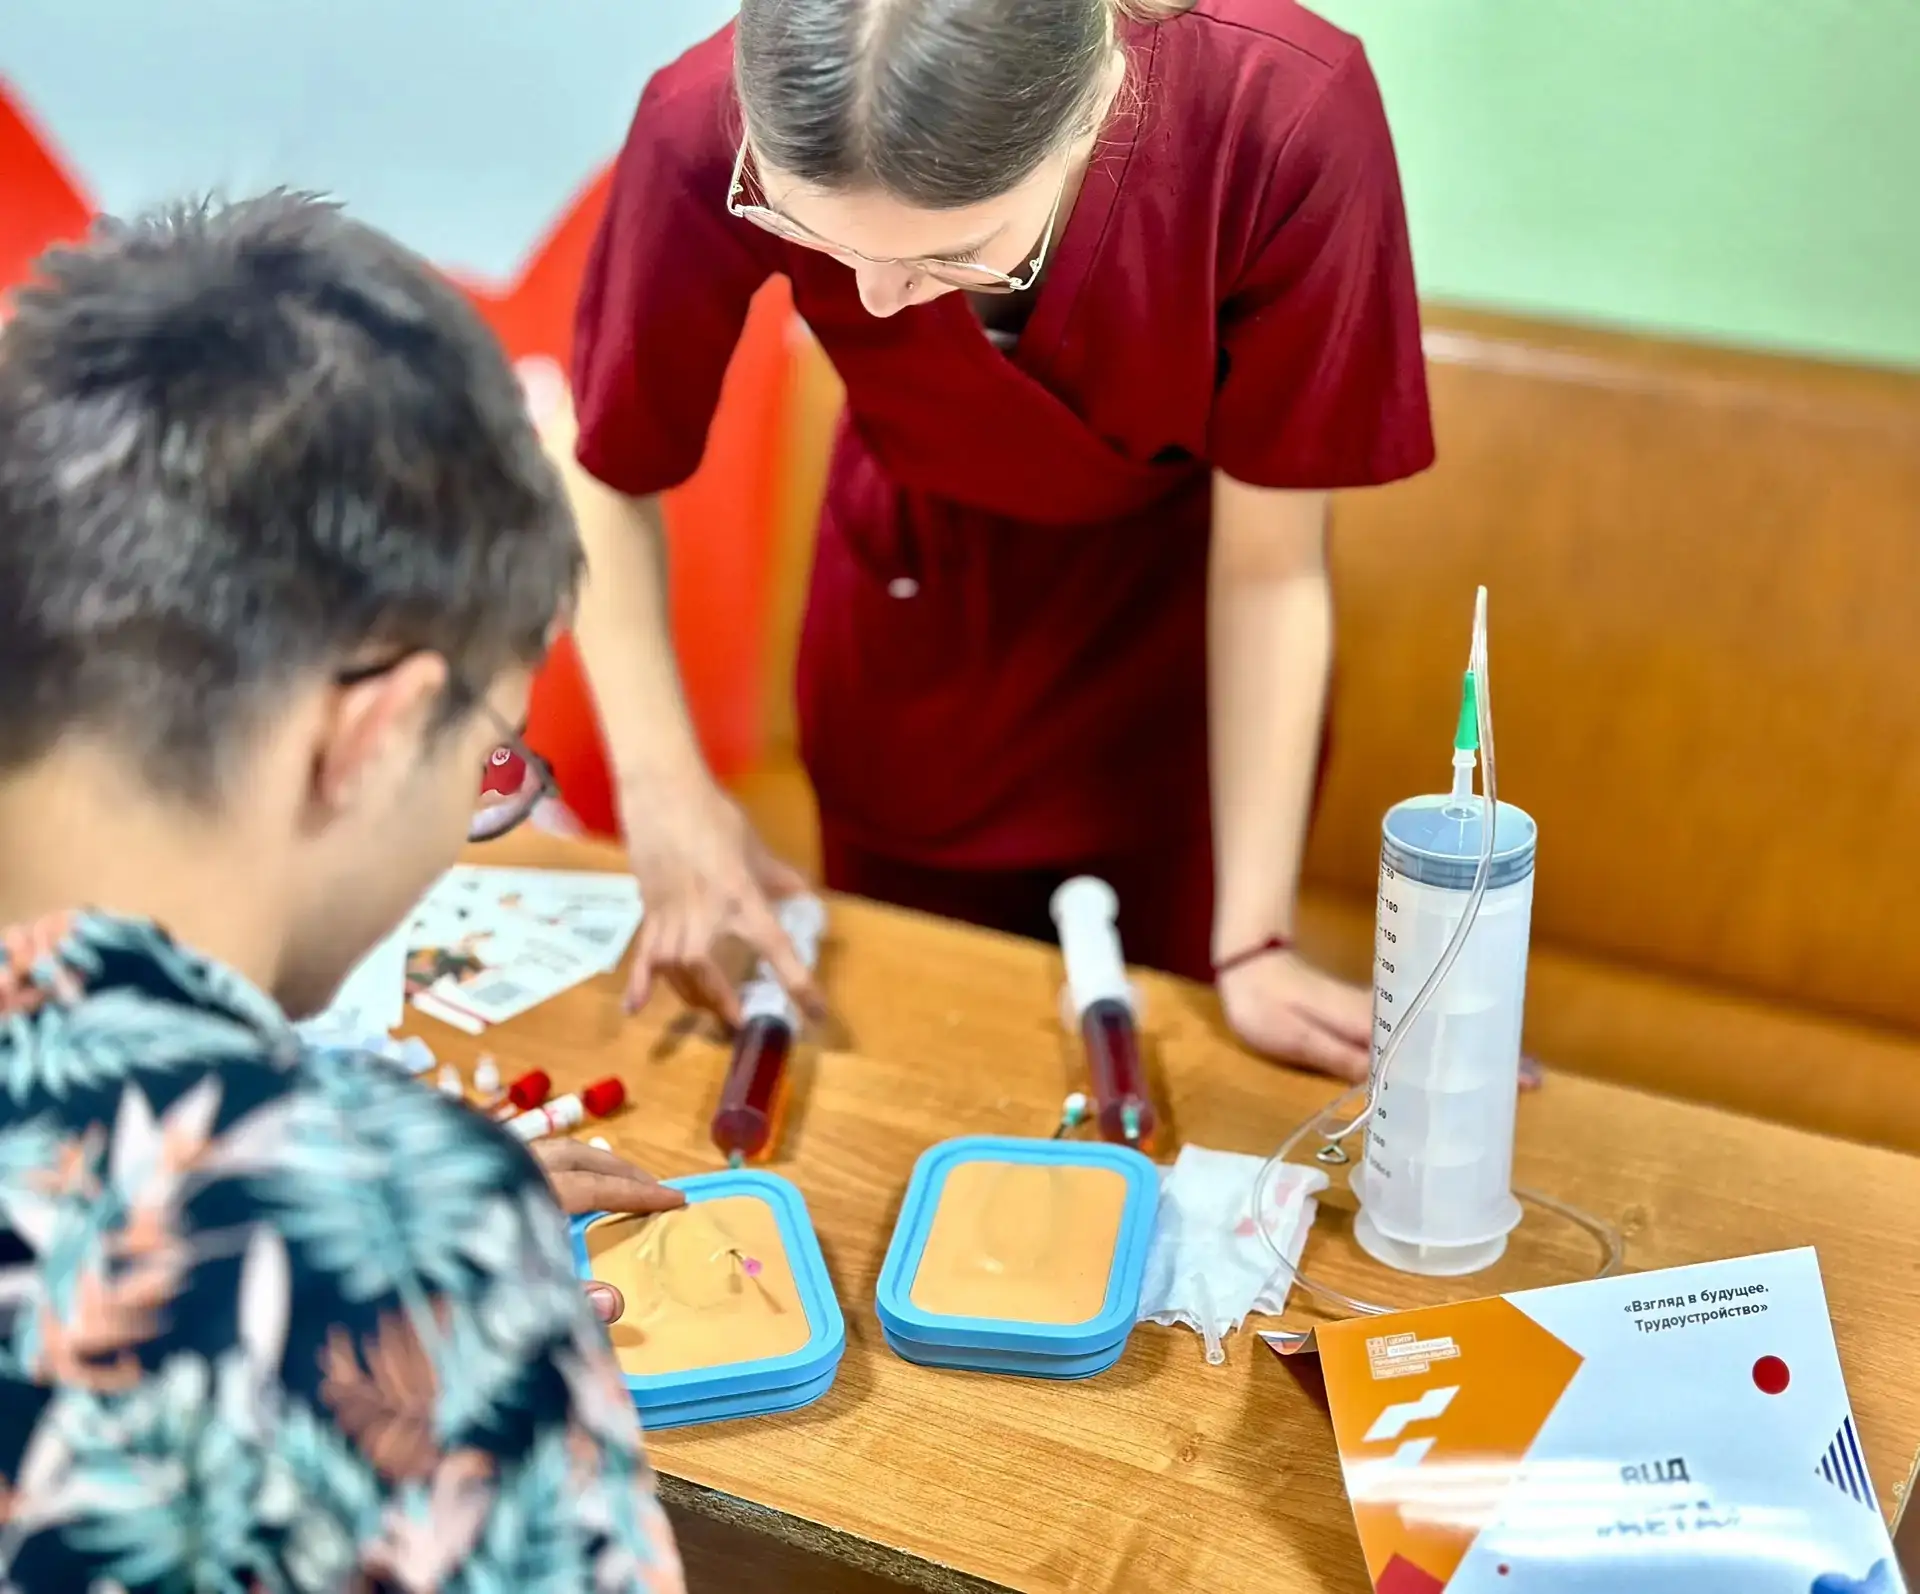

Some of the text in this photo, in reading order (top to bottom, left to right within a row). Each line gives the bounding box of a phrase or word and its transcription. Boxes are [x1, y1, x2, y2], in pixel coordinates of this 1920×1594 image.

[1386, 868, 1394, 879] 50
[1385, 899, 1398, 913] 100
[1383, 929, 1397, 943] 150
[1382, 958, 1395, 973] 200
[1380, 988, 1393, 1003] 250
[1378, 1017, 1391, 1032] 300
[1624, 1284, 1769, 1313] «Взгляд в будущее.
[1635, 1303, 1768, 1332] Трудоустройство»
